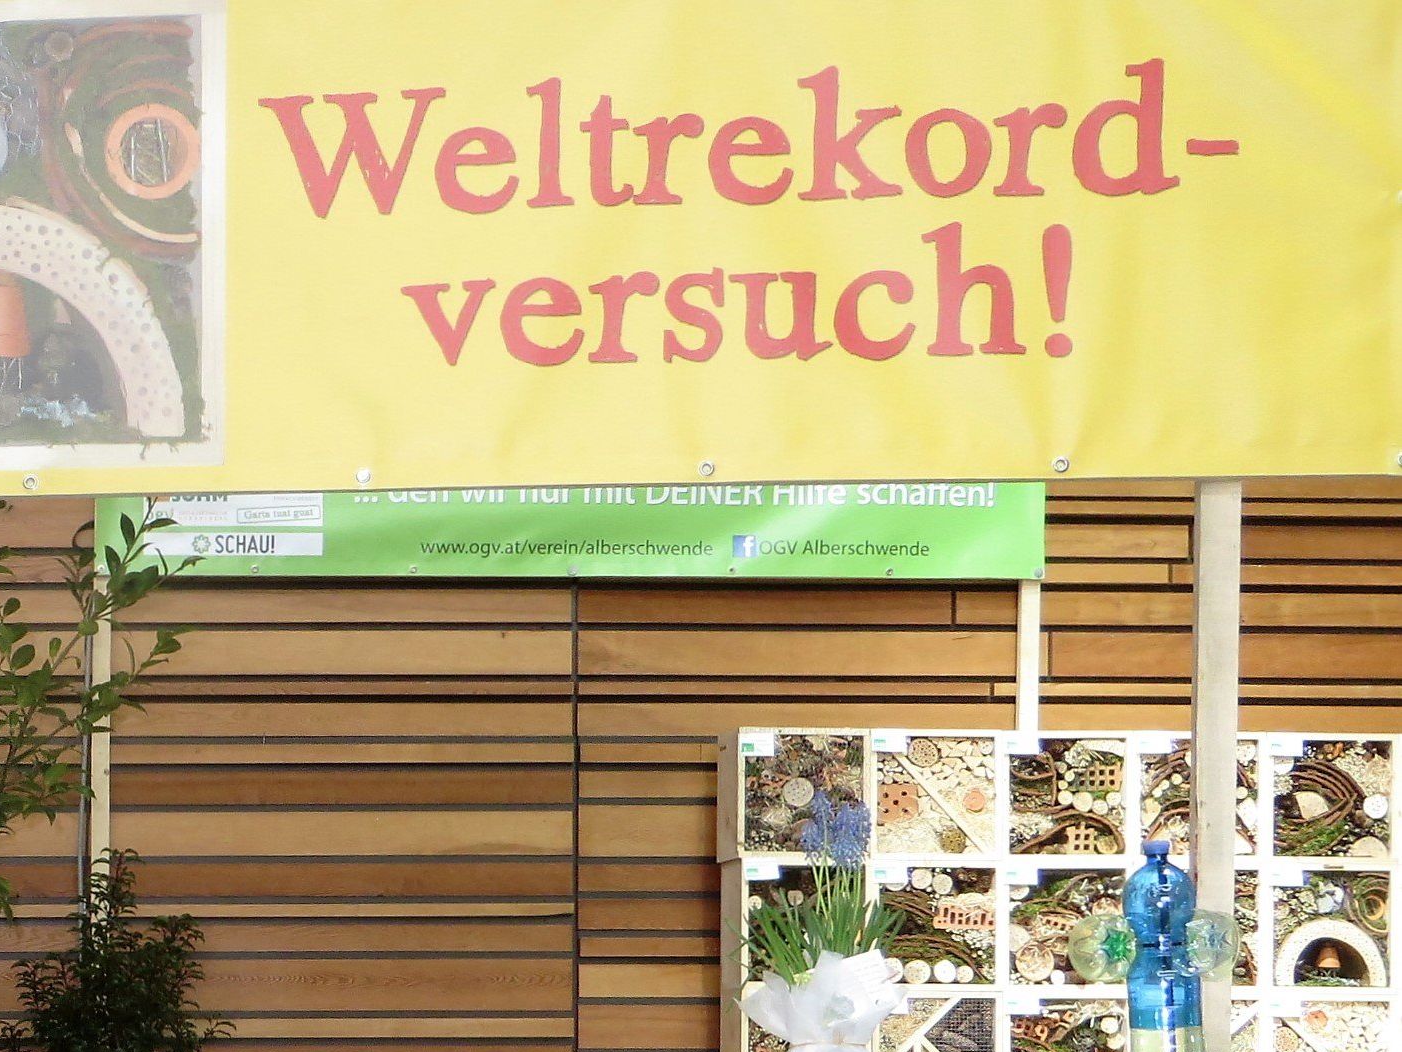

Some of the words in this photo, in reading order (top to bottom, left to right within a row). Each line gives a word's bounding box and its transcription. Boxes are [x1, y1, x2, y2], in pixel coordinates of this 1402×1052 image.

[258, 57, 1240, 219] Weltrekord-
[400, 221, 1073, 367] versuch!
[215, 534, 275, 554] SCHAU!
[420, 537, 714, 558] www.ogv.at/verein/alberschwende
[759, 540, 797, 556] OGV
[802, 538, 930, 557] Alberschwende
